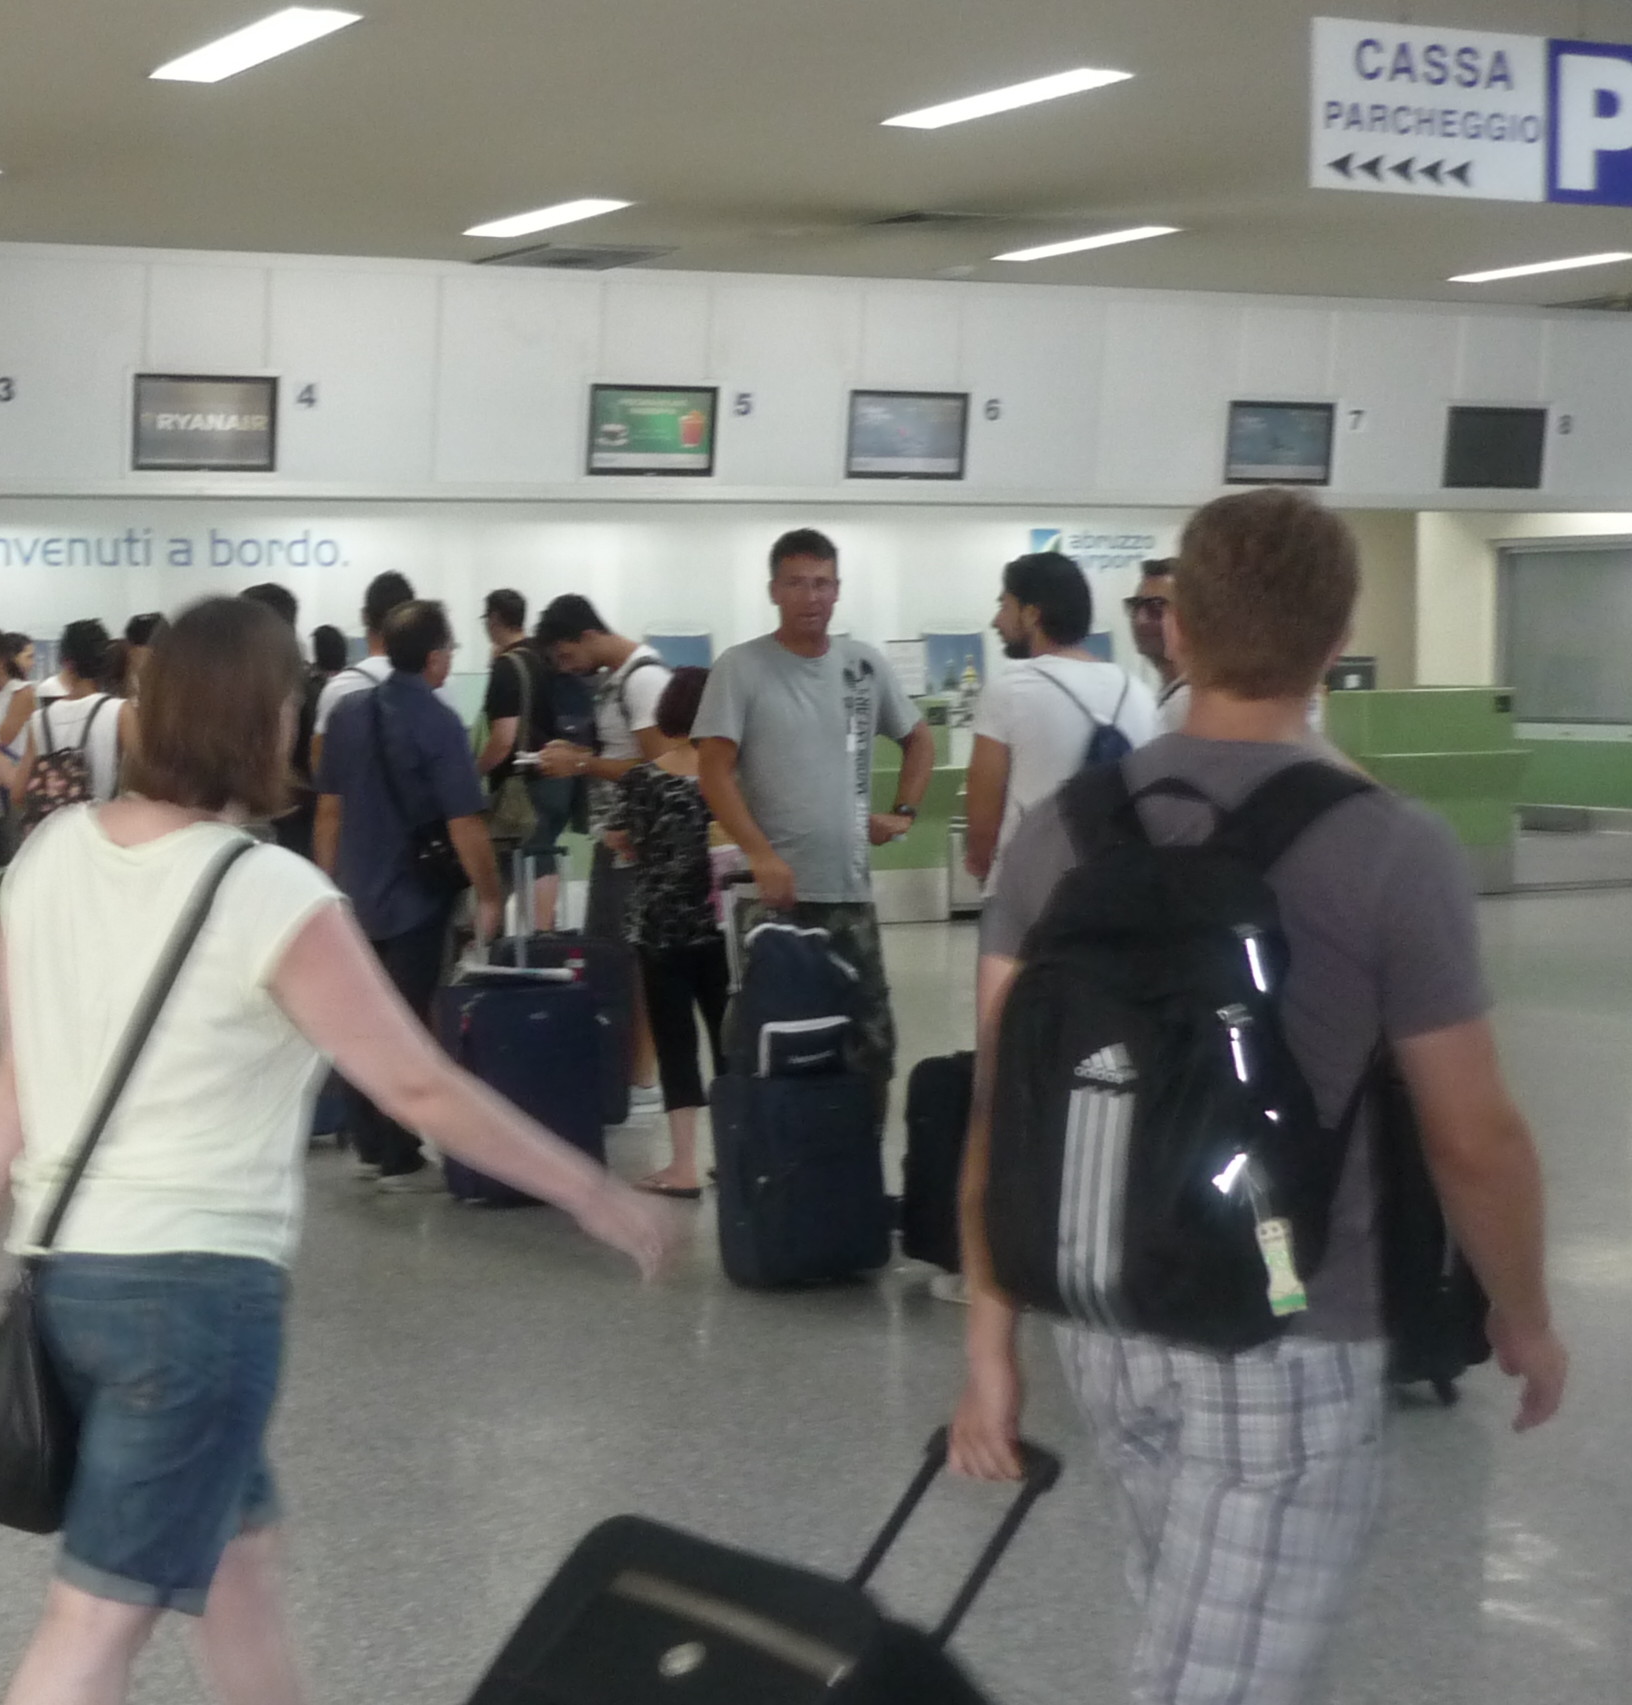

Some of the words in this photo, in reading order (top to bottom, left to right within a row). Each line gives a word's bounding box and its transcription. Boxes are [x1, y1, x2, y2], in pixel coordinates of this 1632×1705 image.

[1354, 37, 1515, 91] CASSA
[1323, 100, 1541, 144] PARCHEGGIO
[1557, 53, 1632, 191] P
[296, 382, 318, 408] 4
[733, 392, 753, 416] 5
[984, 398, 1002, 422] 6
[1349, 409, 1366, 430] 7
[167, 537, 194, 567] a
